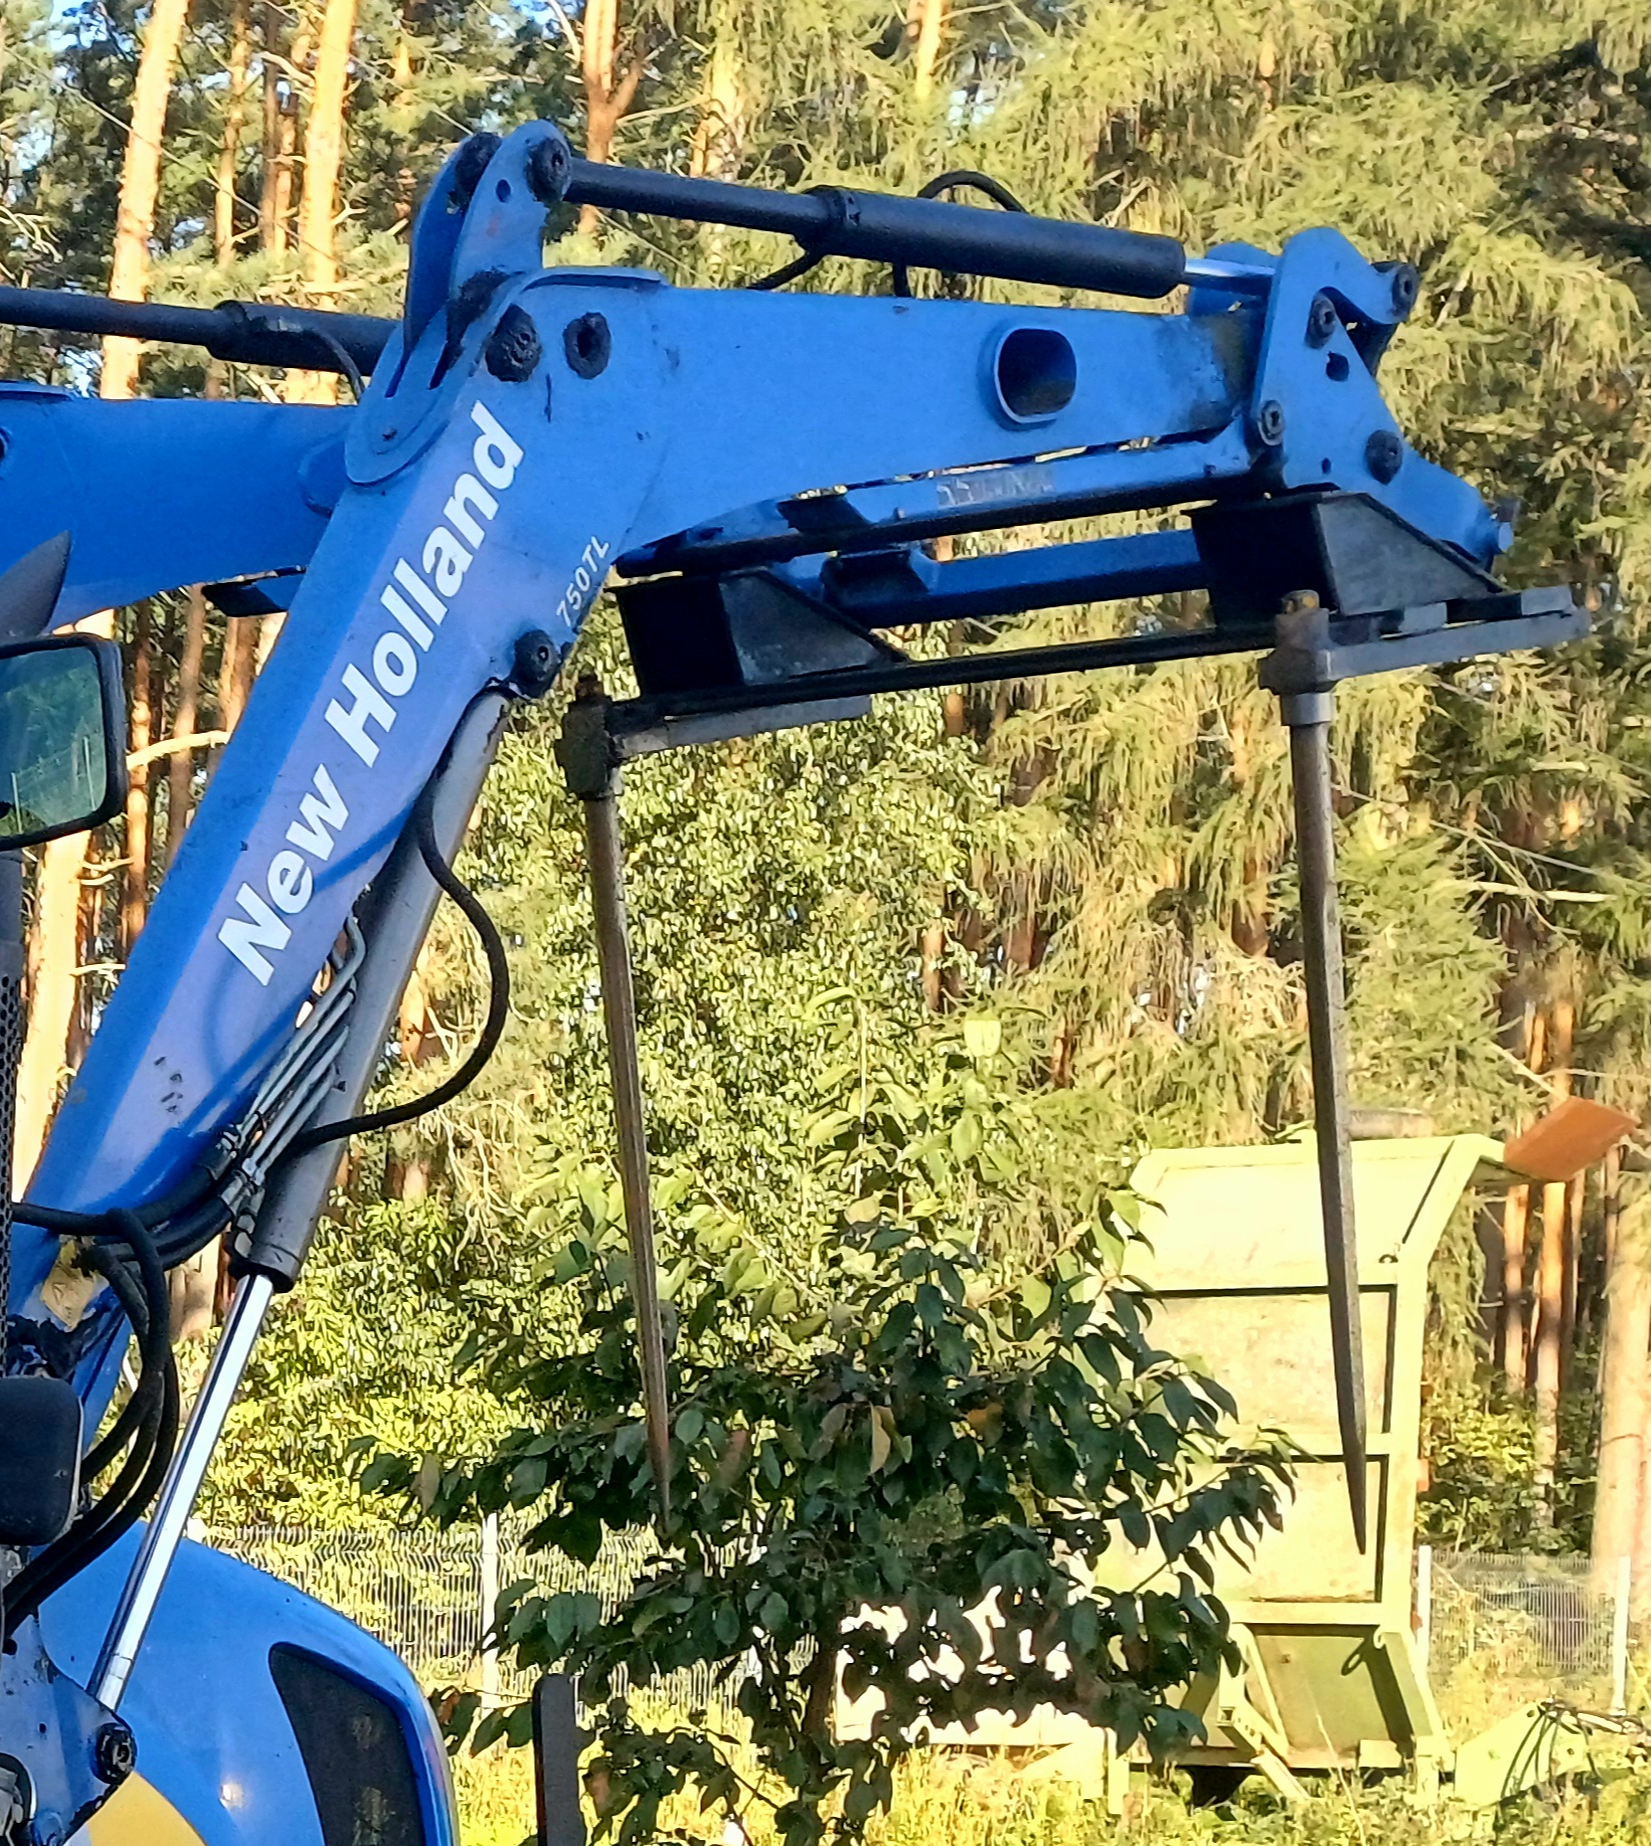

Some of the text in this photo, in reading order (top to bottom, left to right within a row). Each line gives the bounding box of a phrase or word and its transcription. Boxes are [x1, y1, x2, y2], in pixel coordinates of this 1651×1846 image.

[218, 401, 525, 985] New Holland
[556, 535, 610, 627] 750TL
